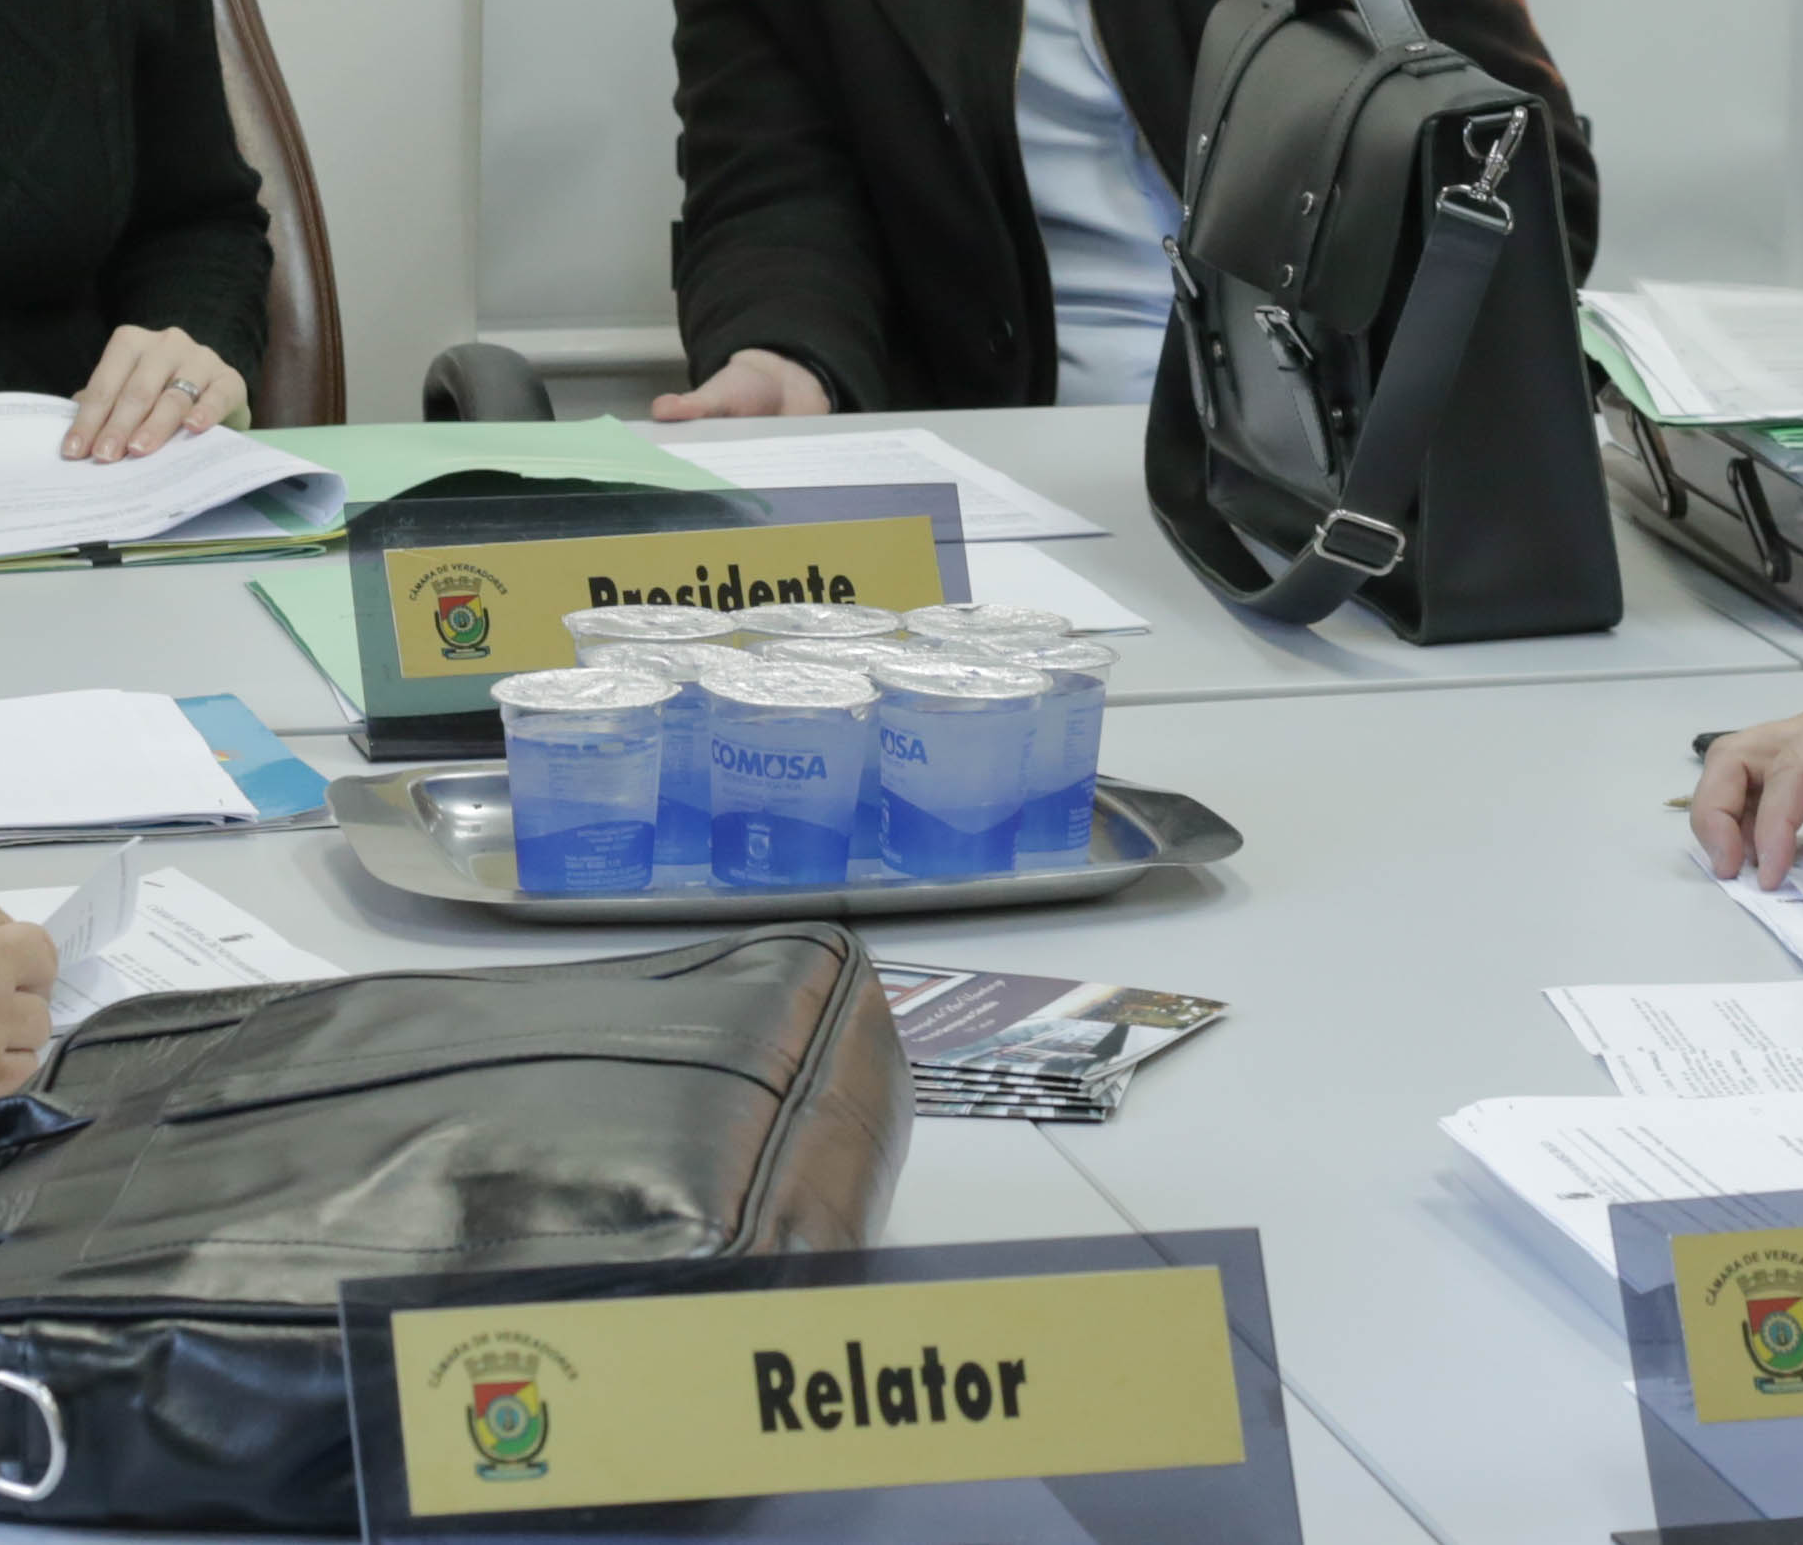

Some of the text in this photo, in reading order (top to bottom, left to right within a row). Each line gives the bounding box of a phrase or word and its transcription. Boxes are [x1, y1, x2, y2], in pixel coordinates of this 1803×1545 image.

[436, 563, 449, 575] DE
[451, 563, 508, 596] VEREADORES
[711, 737, 828, 782] COMUSA
[1742, 1251, 1760, 1266] DE
[752, 1339, 1028, 1436] Relator
